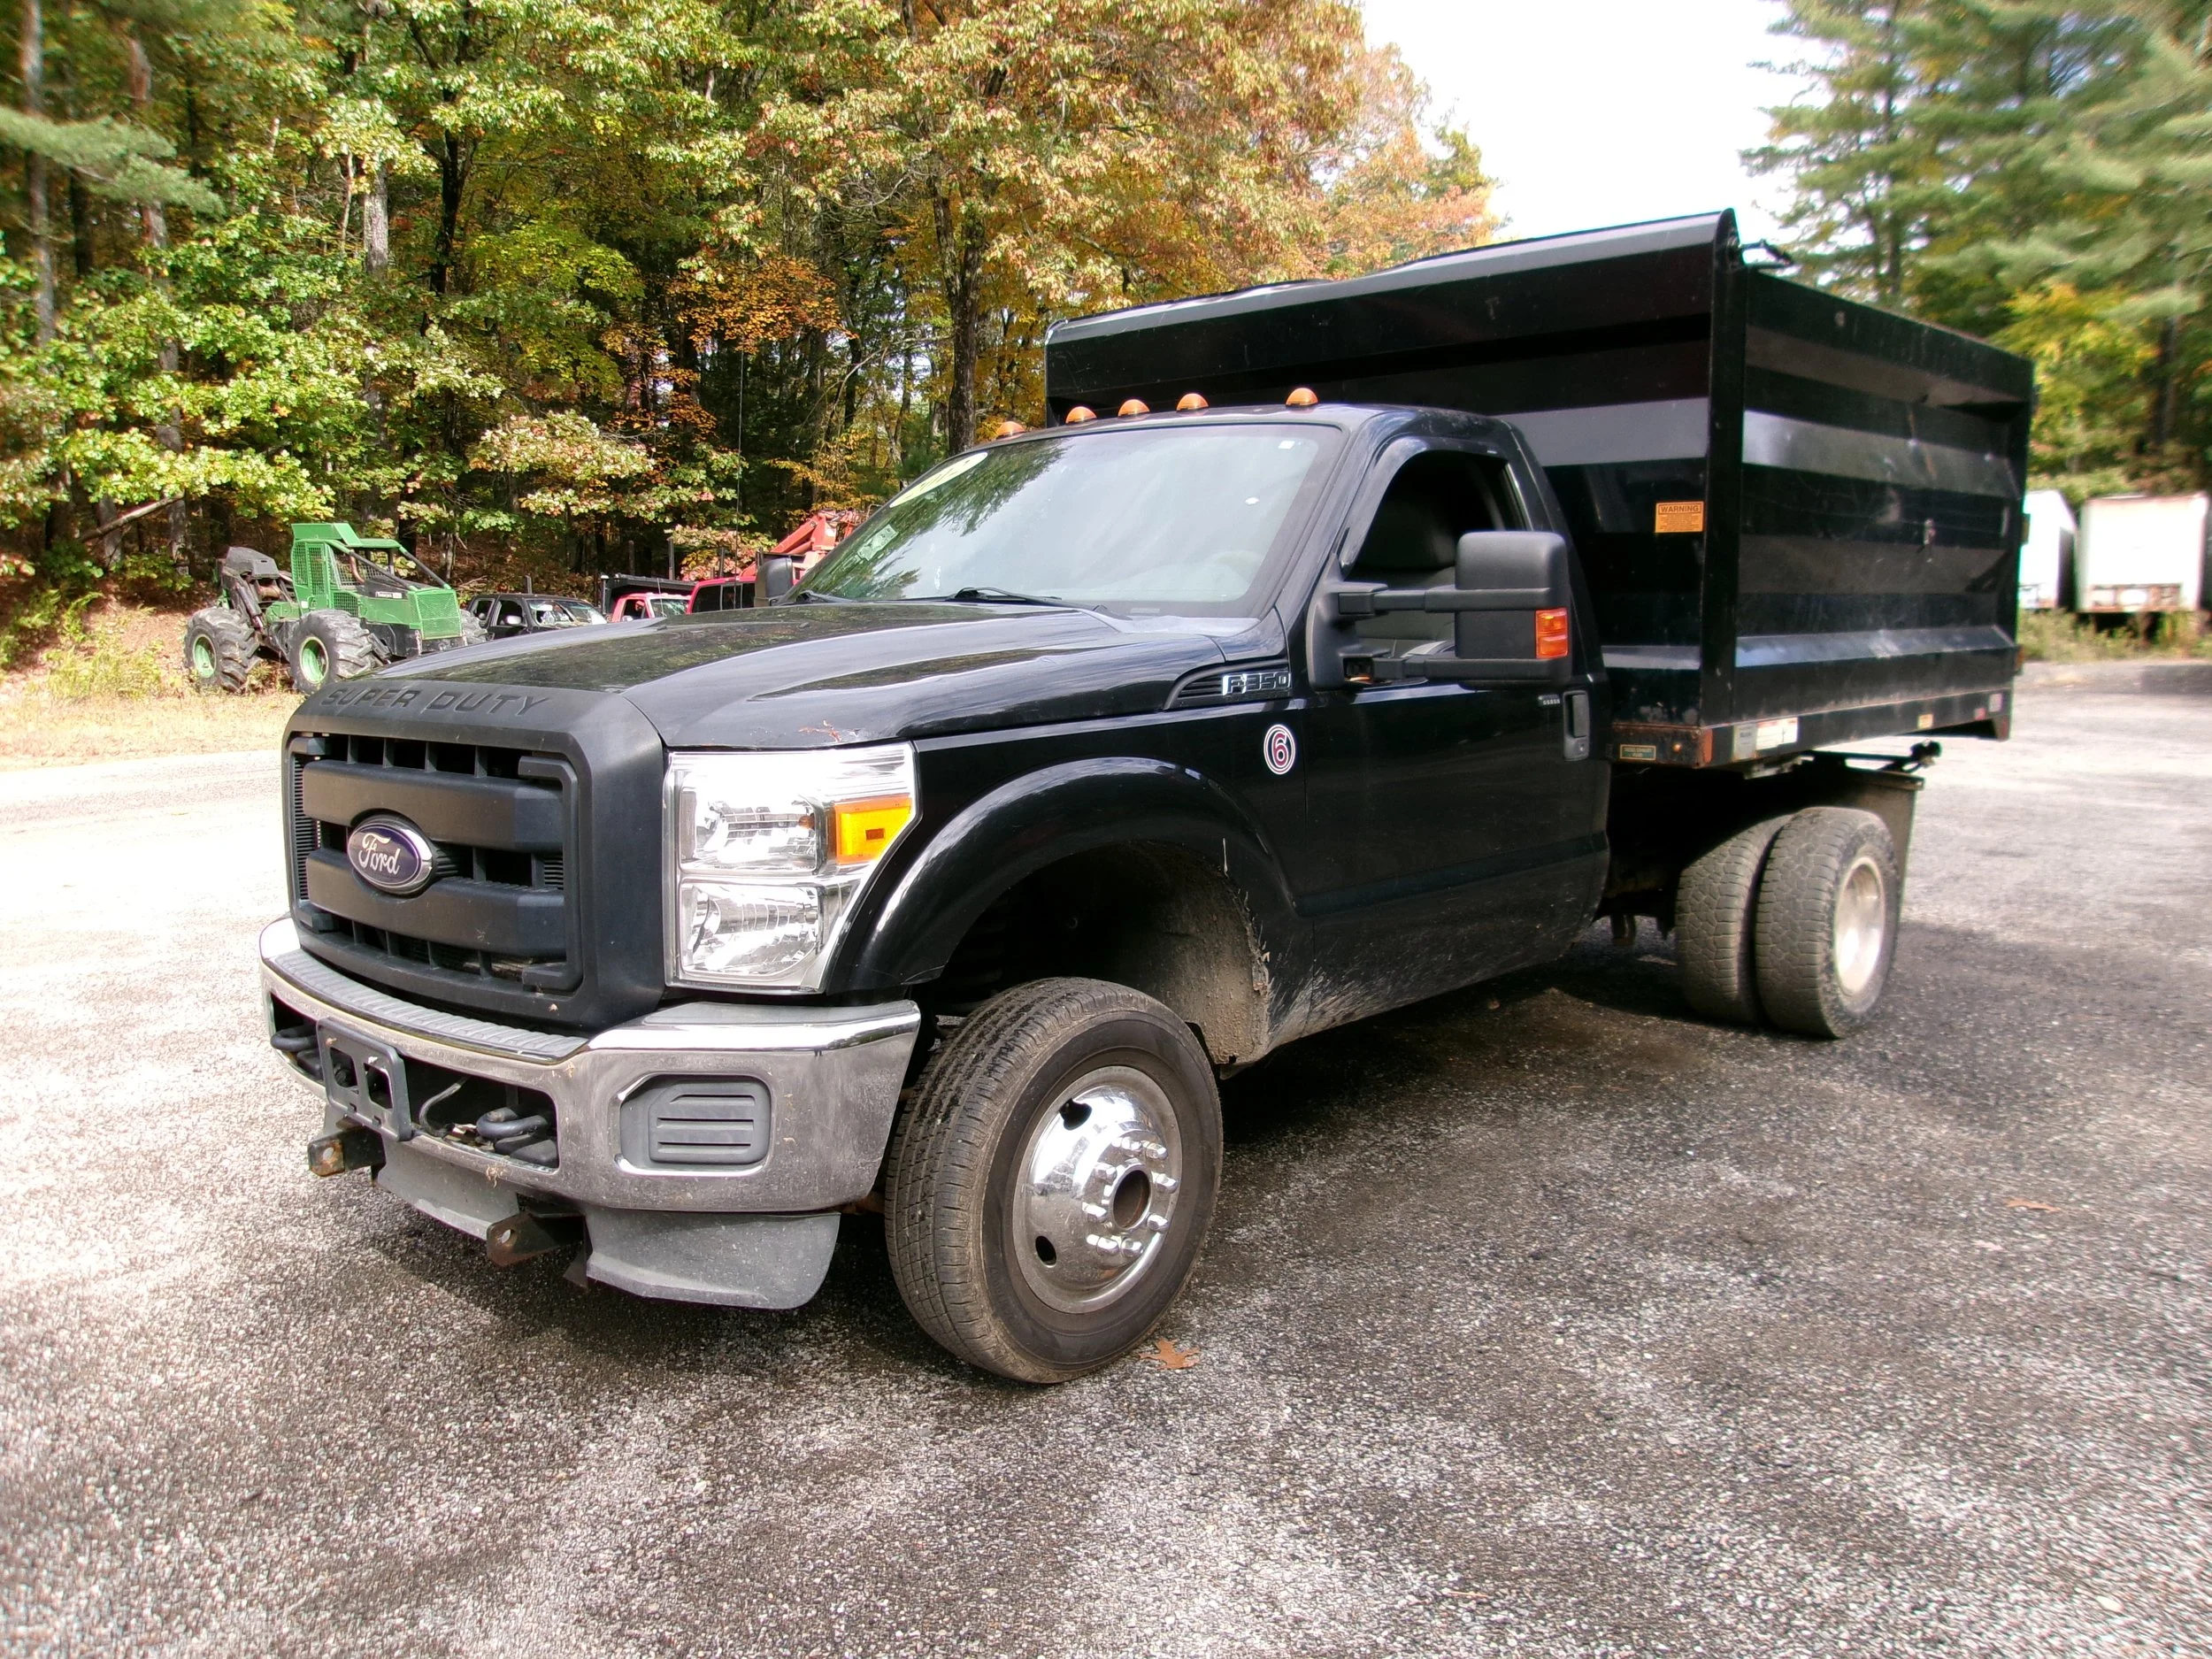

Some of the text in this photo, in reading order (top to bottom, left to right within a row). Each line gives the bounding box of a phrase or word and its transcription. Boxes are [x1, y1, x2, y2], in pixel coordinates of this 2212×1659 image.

[320, 687, 546, 716] SUPER DUTY
[1271, 732, 1289, 768] 6
[358, 833, 401, 874] Ford
